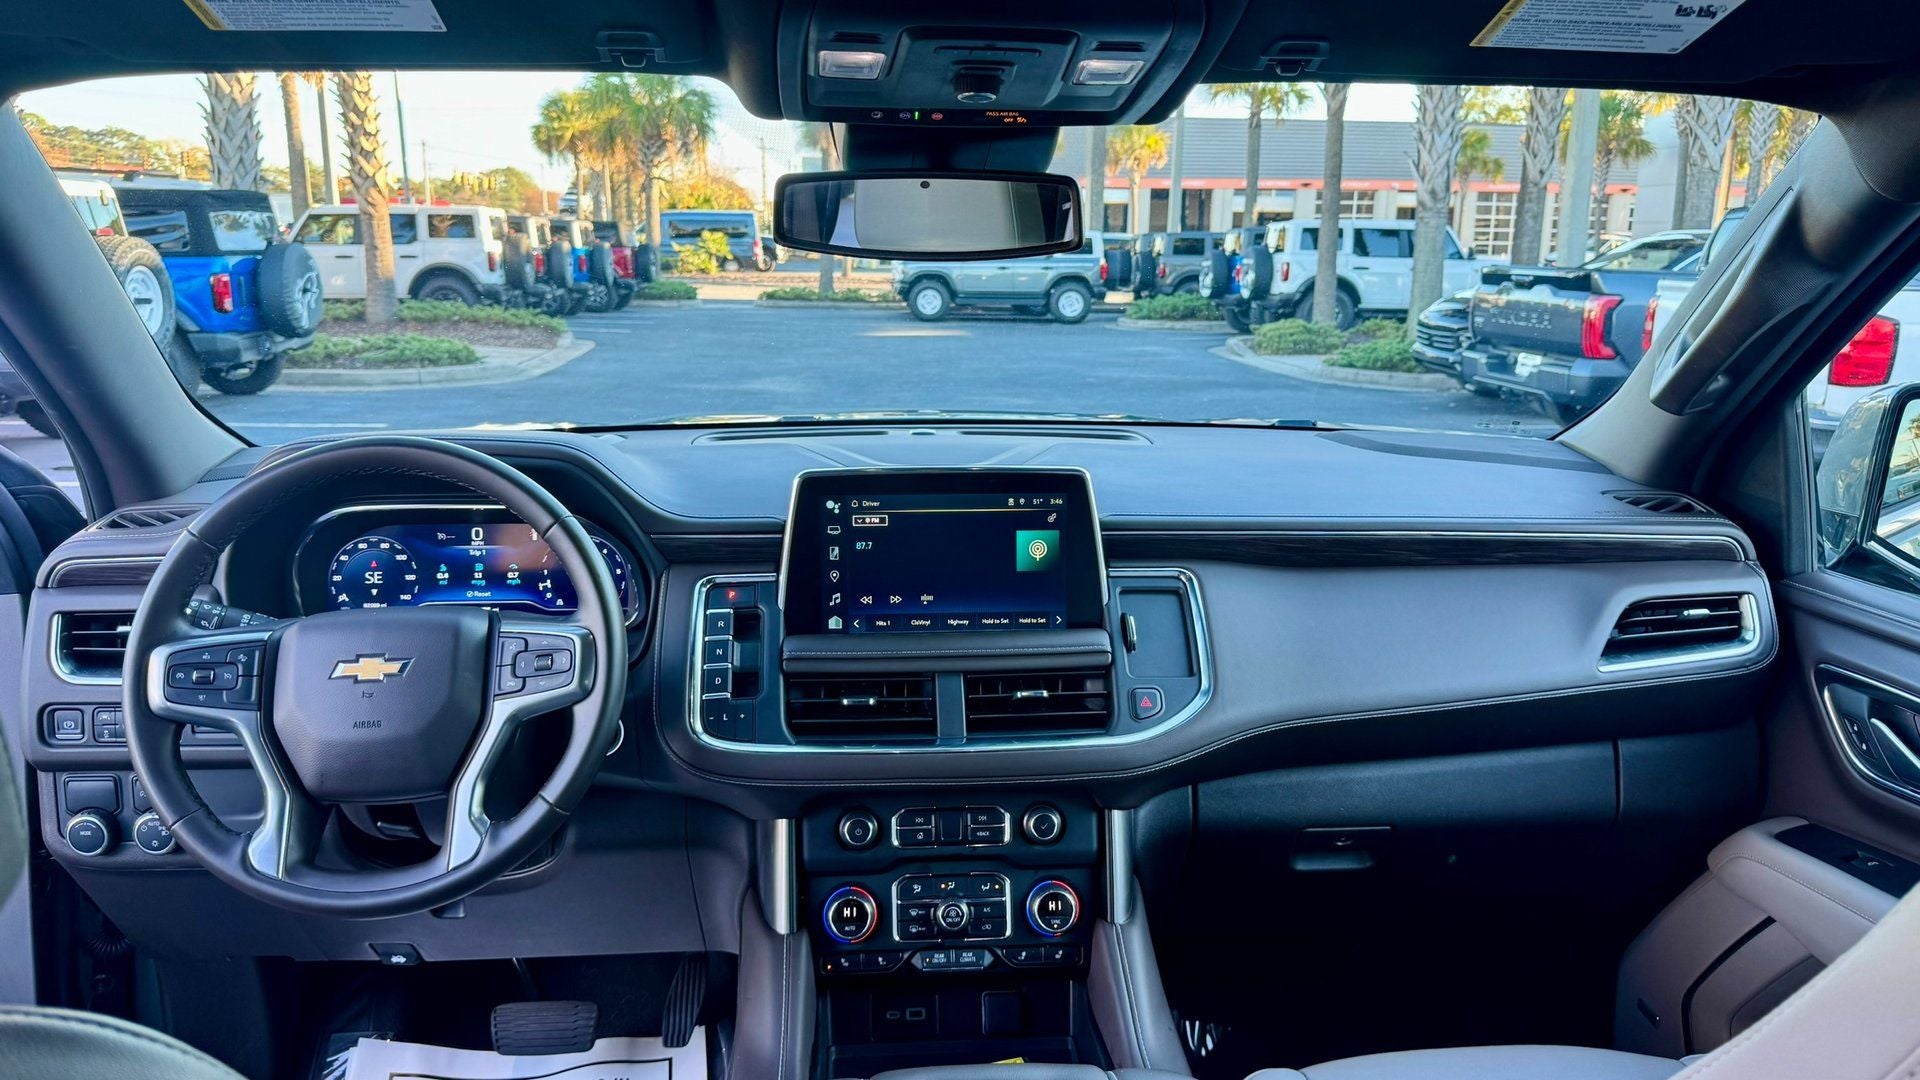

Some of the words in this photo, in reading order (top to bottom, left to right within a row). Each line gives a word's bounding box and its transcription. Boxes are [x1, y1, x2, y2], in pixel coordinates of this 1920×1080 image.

[471, 527, 484, 541] 0
[856, 541, 873, 550] 87.7
[469, 549, 482, 557] Trip
[364, 571, 384, 585] SE
[947, 618, 969, 626] Highway
[715, 677, 722, 685] D
[723, 713, 729, 721] L
[353, 720, 382, 729] AIRBAG
[1048, 900, 1062, 911] HI
[843, 906, 857, 918] HI
